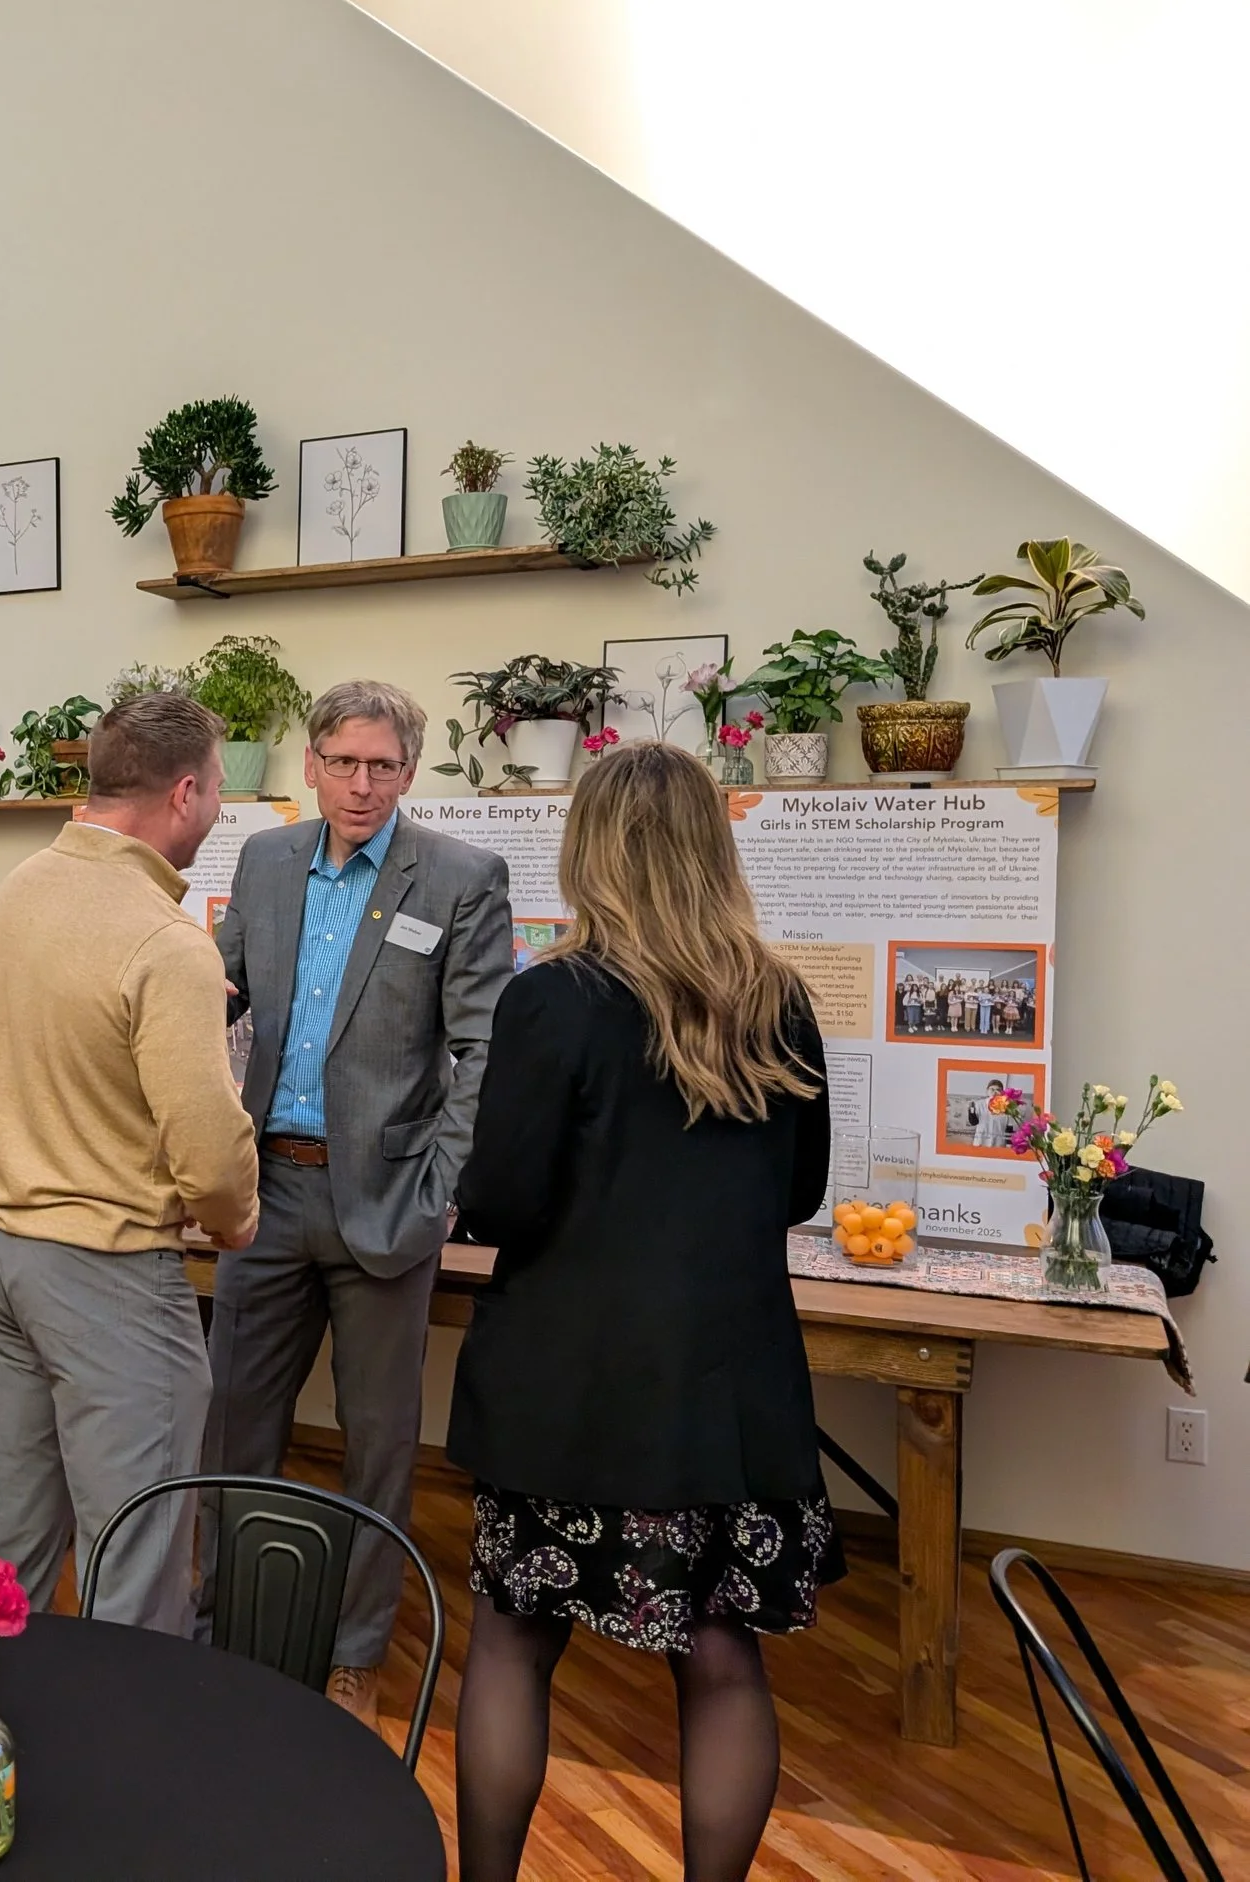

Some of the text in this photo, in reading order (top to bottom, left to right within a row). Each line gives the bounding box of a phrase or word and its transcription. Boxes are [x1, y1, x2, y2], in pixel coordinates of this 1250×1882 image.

[783, 794, 986, 817] Mykolaiv Water Hub
[411, 806, 434, 819] No
[440, 806, 482, 819] More
[488, 805, 541, 822] Empty
[760, 818, 1004, 833] Girls in STEM Scholarship Program
[511, 828, 533, 836] provide
[747, 837, 776, 846] Mykolaiv
[906, 837, 921, 845] City
[933, 836, 967, 845] Mykolaiv,
[1002, 836, 1020, 845] They
[768, 846, 794, 855] support
[833, 846, 862, 855] drinking
[909, 846, 935, 854] people
[947, 846, 980, 854] Mykolaiv,
[746, 856, 774, 864] ongoing
[966, 855, 998, 864] damage,
[1002, 855, 1019, 864] they
[803, 865, 837, 874] preparing
[750, 874, 776, 882] primary
[778, 874, 813, 882] objectives
[828, 874, 866, 883] knowledge
[884, 874, 924, 883] technology
[926, 874, 954, 883] sharing,
[957, 875, 987, 884] capacity
[989, 875, 1022, 884] building,
[825, 892, 856, 901] investing
[899, 893, 938, 902] generation
[1003, 894, 1040, 903] providing
[788, 901, 828, 910] mentorship,
[844, 902, 882, 911] equipment
[975, 904, 1015, 913] passionate
[785, 910, 809, 919] special
[845, 911, 867, 919] water,
[782, 930, 823, 939] Mission
[805, 954, 834, 963] provides
[836, 954, 862, 964] funding
[823, 991, 868, 1001] development
[908, 1200, 982, 1225] hanks
[925, 1224, 1002, 1238] november 2025
